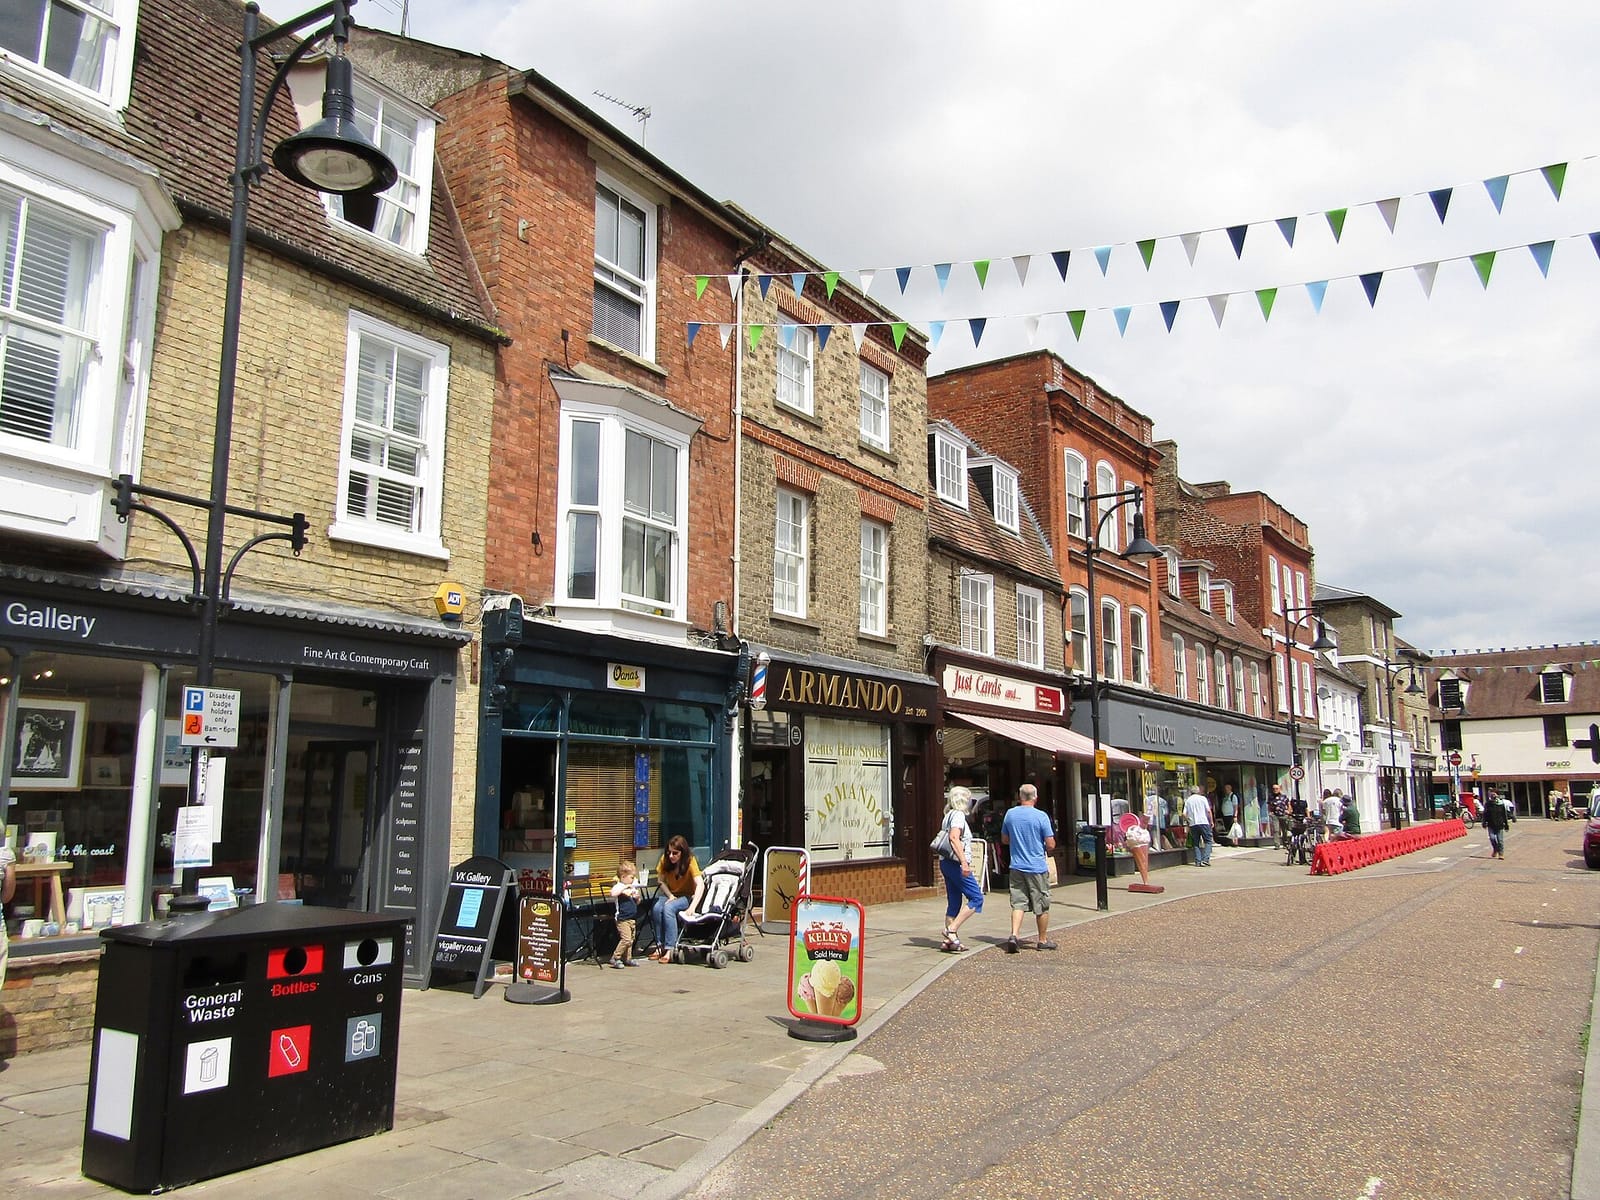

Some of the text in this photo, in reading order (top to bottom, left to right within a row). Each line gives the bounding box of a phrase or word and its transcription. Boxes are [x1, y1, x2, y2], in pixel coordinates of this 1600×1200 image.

[448, 594, 460, 605] ADT
[6, 602, 96, 638] Gallery
[303, 646, 429, 671] Fine Art & Contemporary Craft
[778, 668, 903, 714] ARMANDO
[953, 670, 973, 692] Just
[976, 675, 1002, 698] Cards
[190, 692, 202, 709] P
[209, 691, 236, 701] Disabled
[807, 743, 833, 755] Gents
[836, 741, 857, 757] Hair
[1438, 763, 1482, 773] Poudlad
[816, 782, 884, 827] ARMANDO
[60, 844, 70, 856] to
[72, 844, 87, 856] the
[90, 844, 115, 856] coast
[466, 872, 492, 886] Gallery
[808, 932, 848, 944] KELLY'S
[814, 951, 843, 959] Sold Here
[353, 972, 383, 985] Cans
[272, 982, 318, 998] Bottles
[185, 988, 242, 1009] General
[190, 1005, 235, 1023] Waste
